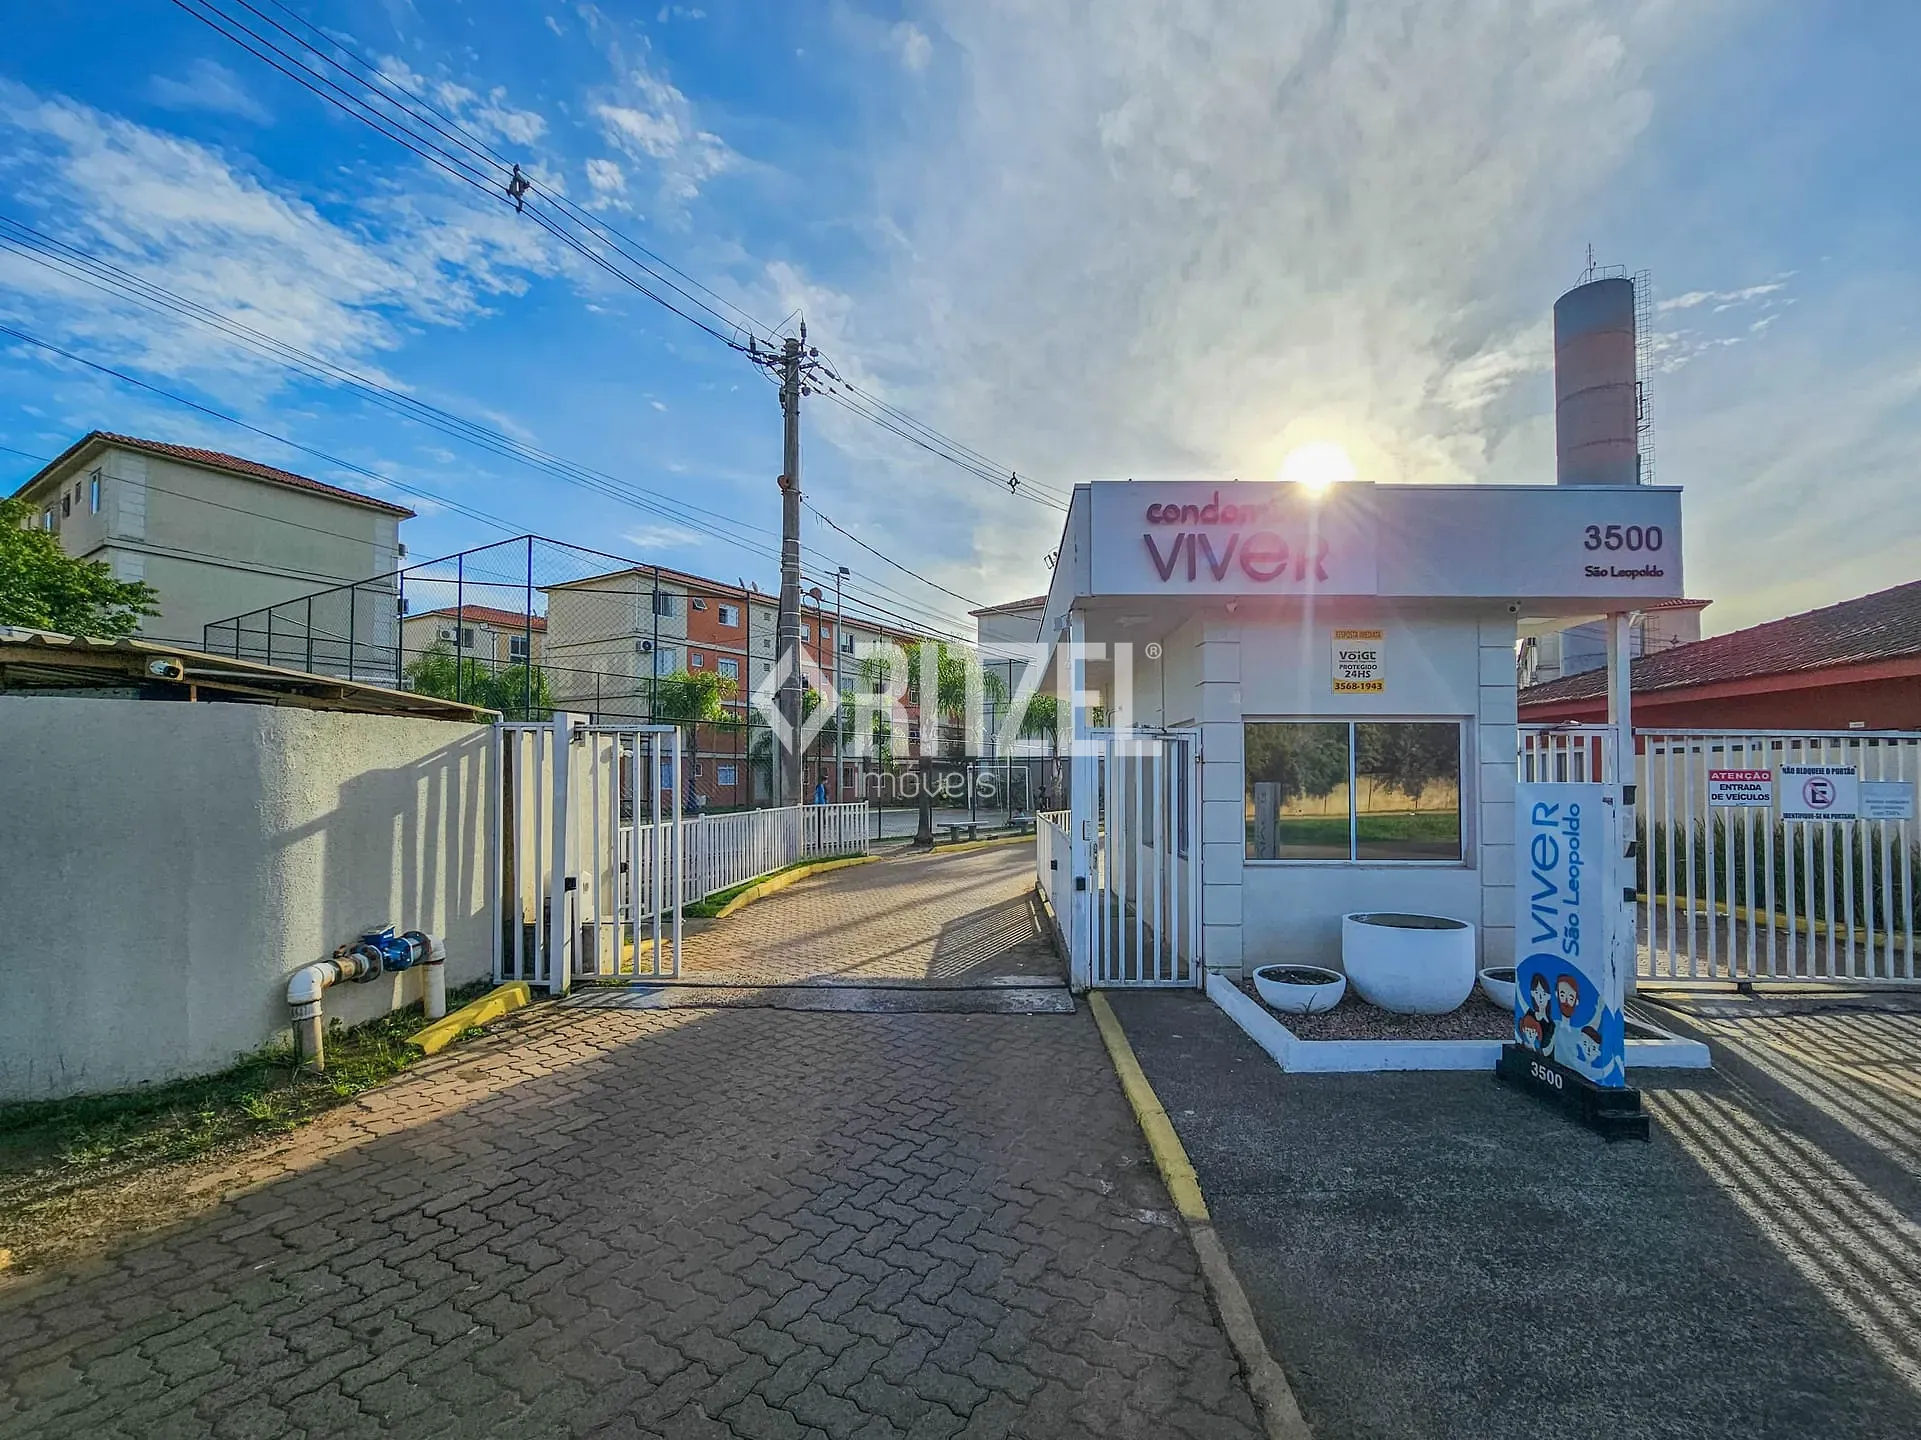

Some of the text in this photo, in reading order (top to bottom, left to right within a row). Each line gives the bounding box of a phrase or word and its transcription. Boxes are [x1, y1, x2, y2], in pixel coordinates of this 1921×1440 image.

[1584, 525, 1663, 551] 3500
[1584, 564, 1664, 579] São Leopoldo
[1344, 670, 1371, 678] 24HS
[1335, 682, 1383, 690] 3568-1943
[1782, 766, 1795, 775] NÃO
[1831, 767, 1856, 775] PORTÃO
[1711, 771, 1770, 780] ATENÇÃO
[1720, 783, 1762, 791] ENTRADA
[1711, 792, 1770, 801] DE VEÍCULOS
[1563, 803, 1585, 957] São Leopoldo
[1531, 1061, 1563, 1090] 3500
